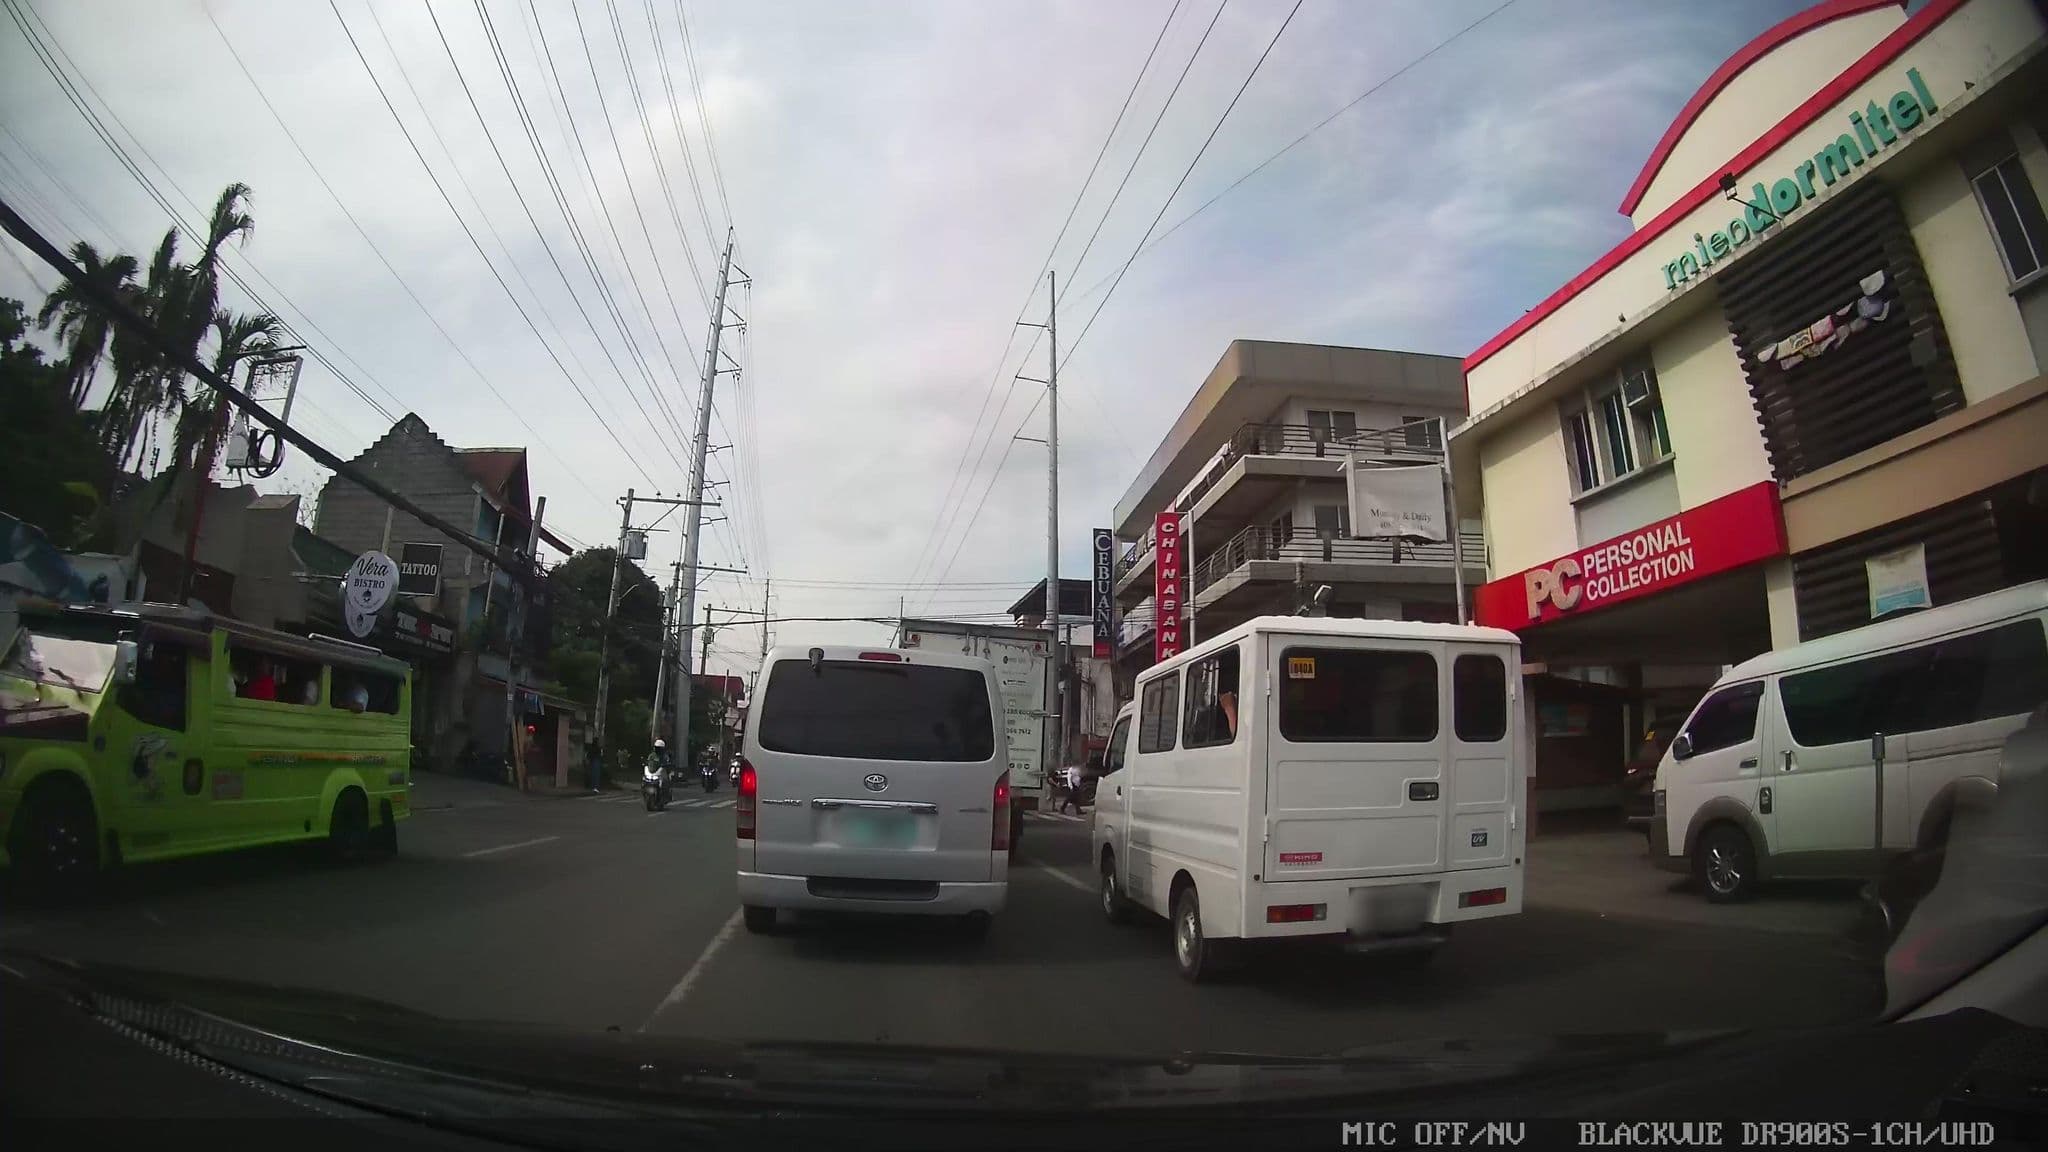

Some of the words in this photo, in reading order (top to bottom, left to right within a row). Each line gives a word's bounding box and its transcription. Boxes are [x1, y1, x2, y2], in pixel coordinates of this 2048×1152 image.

[357, 556, 389, 577] Vera
[401, 562, 438, 576] TATTOO
[1583, 521, 1691, 578] PERSONAL
[1586, 547, 1695, 601] COLLECTION
[354, 578, 385, 590] BISTRO
[1094, 532, 1112, 638] CEBUANA
[1161, 522, 1177, 659] CHINABANK
[1524, 558, 1583, 619] PC
